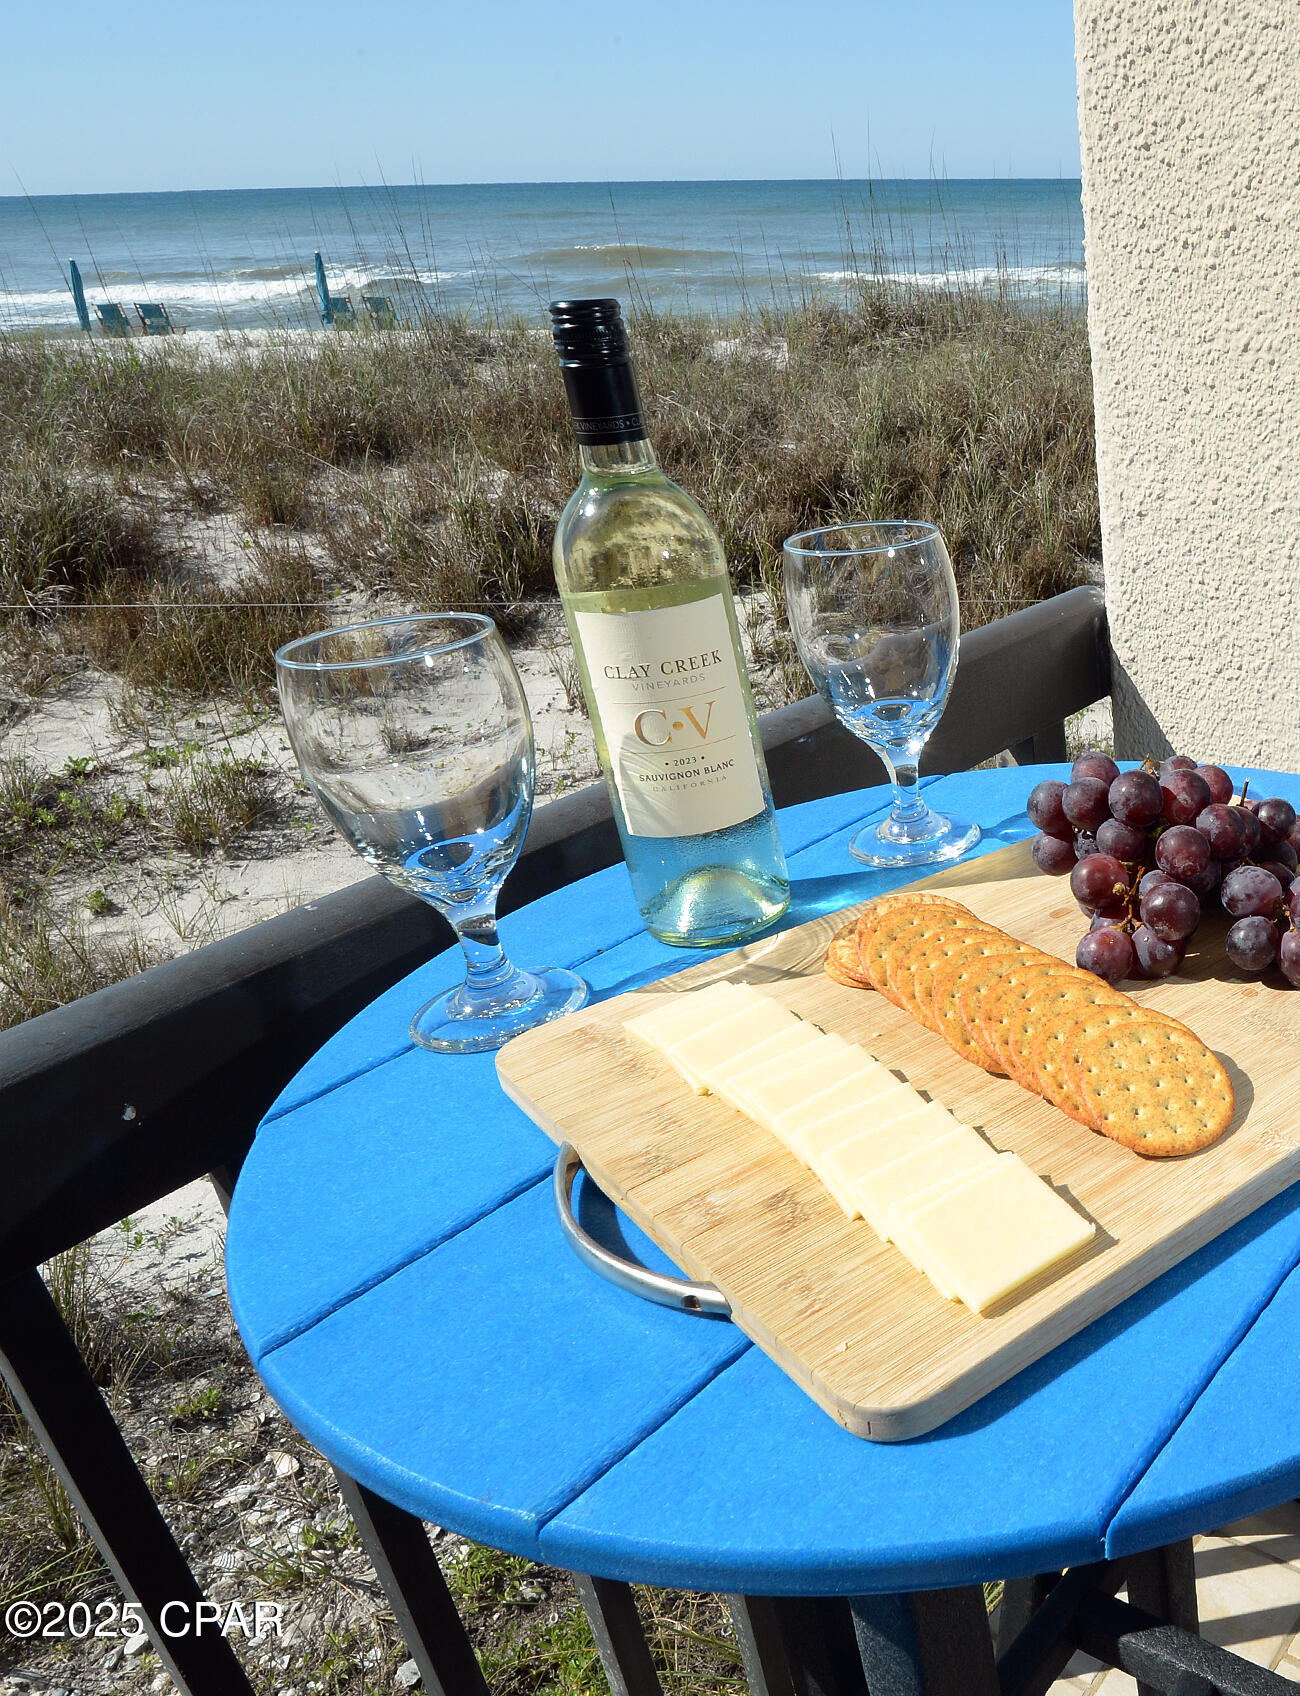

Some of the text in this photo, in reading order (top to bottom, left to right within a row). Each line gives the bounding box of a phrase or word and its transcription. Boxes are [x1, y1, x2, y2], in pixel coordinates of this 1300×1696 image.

[603, 649, 723, 680] CLAY CREEK
[632, 673, 706, 692] VINEYARDS
[639, 759, 735, 782] SAUVIGNON BLANC
[652, 775, 728, 793] CALIFORNIA
